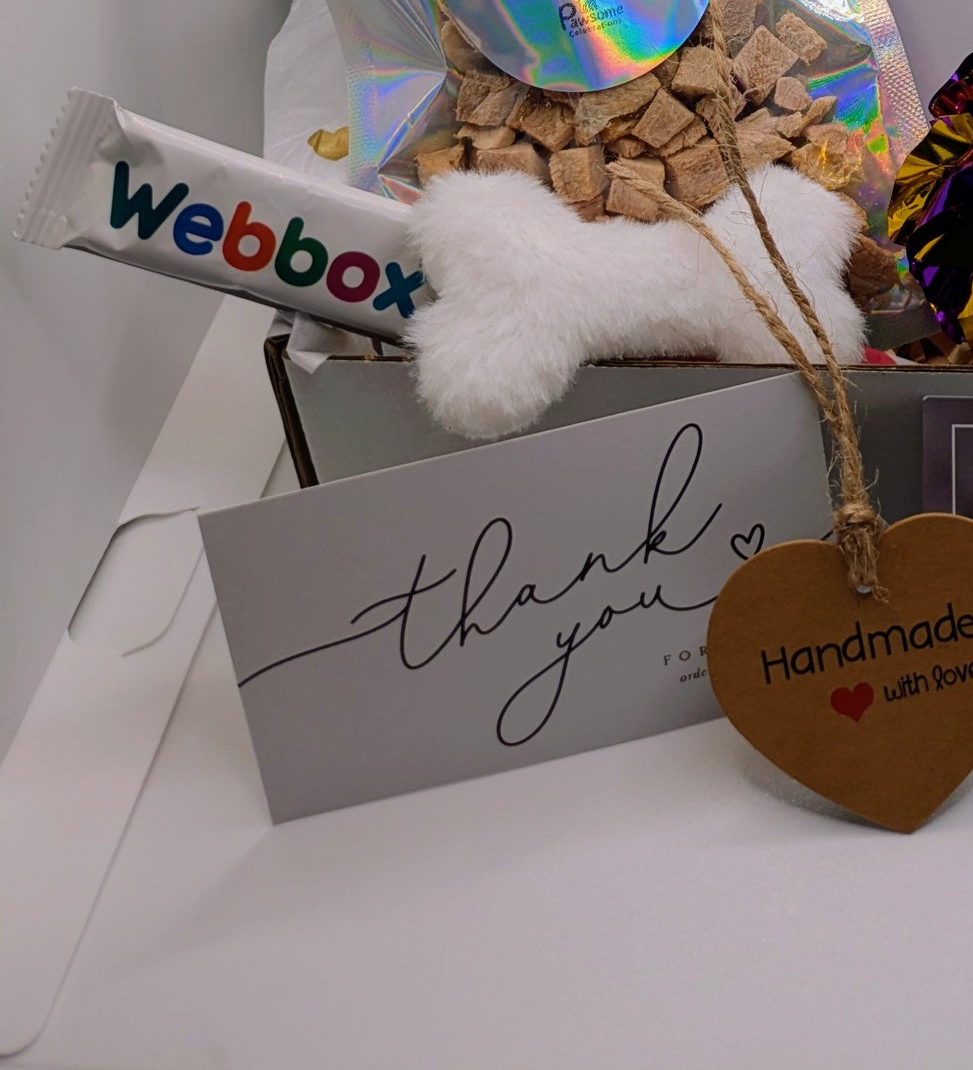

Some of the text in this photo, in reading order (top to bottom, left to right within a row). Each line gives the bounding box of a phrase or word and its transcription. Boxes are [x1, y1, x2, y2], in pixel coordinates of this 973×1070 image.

[559, 3, 624, 31] Pawsome
[109, 160, 427, 319] Webbox
[238, 422, 723, 688] thank
[496, 584, 720, 747] you
[883, 674, 930, 703] with
